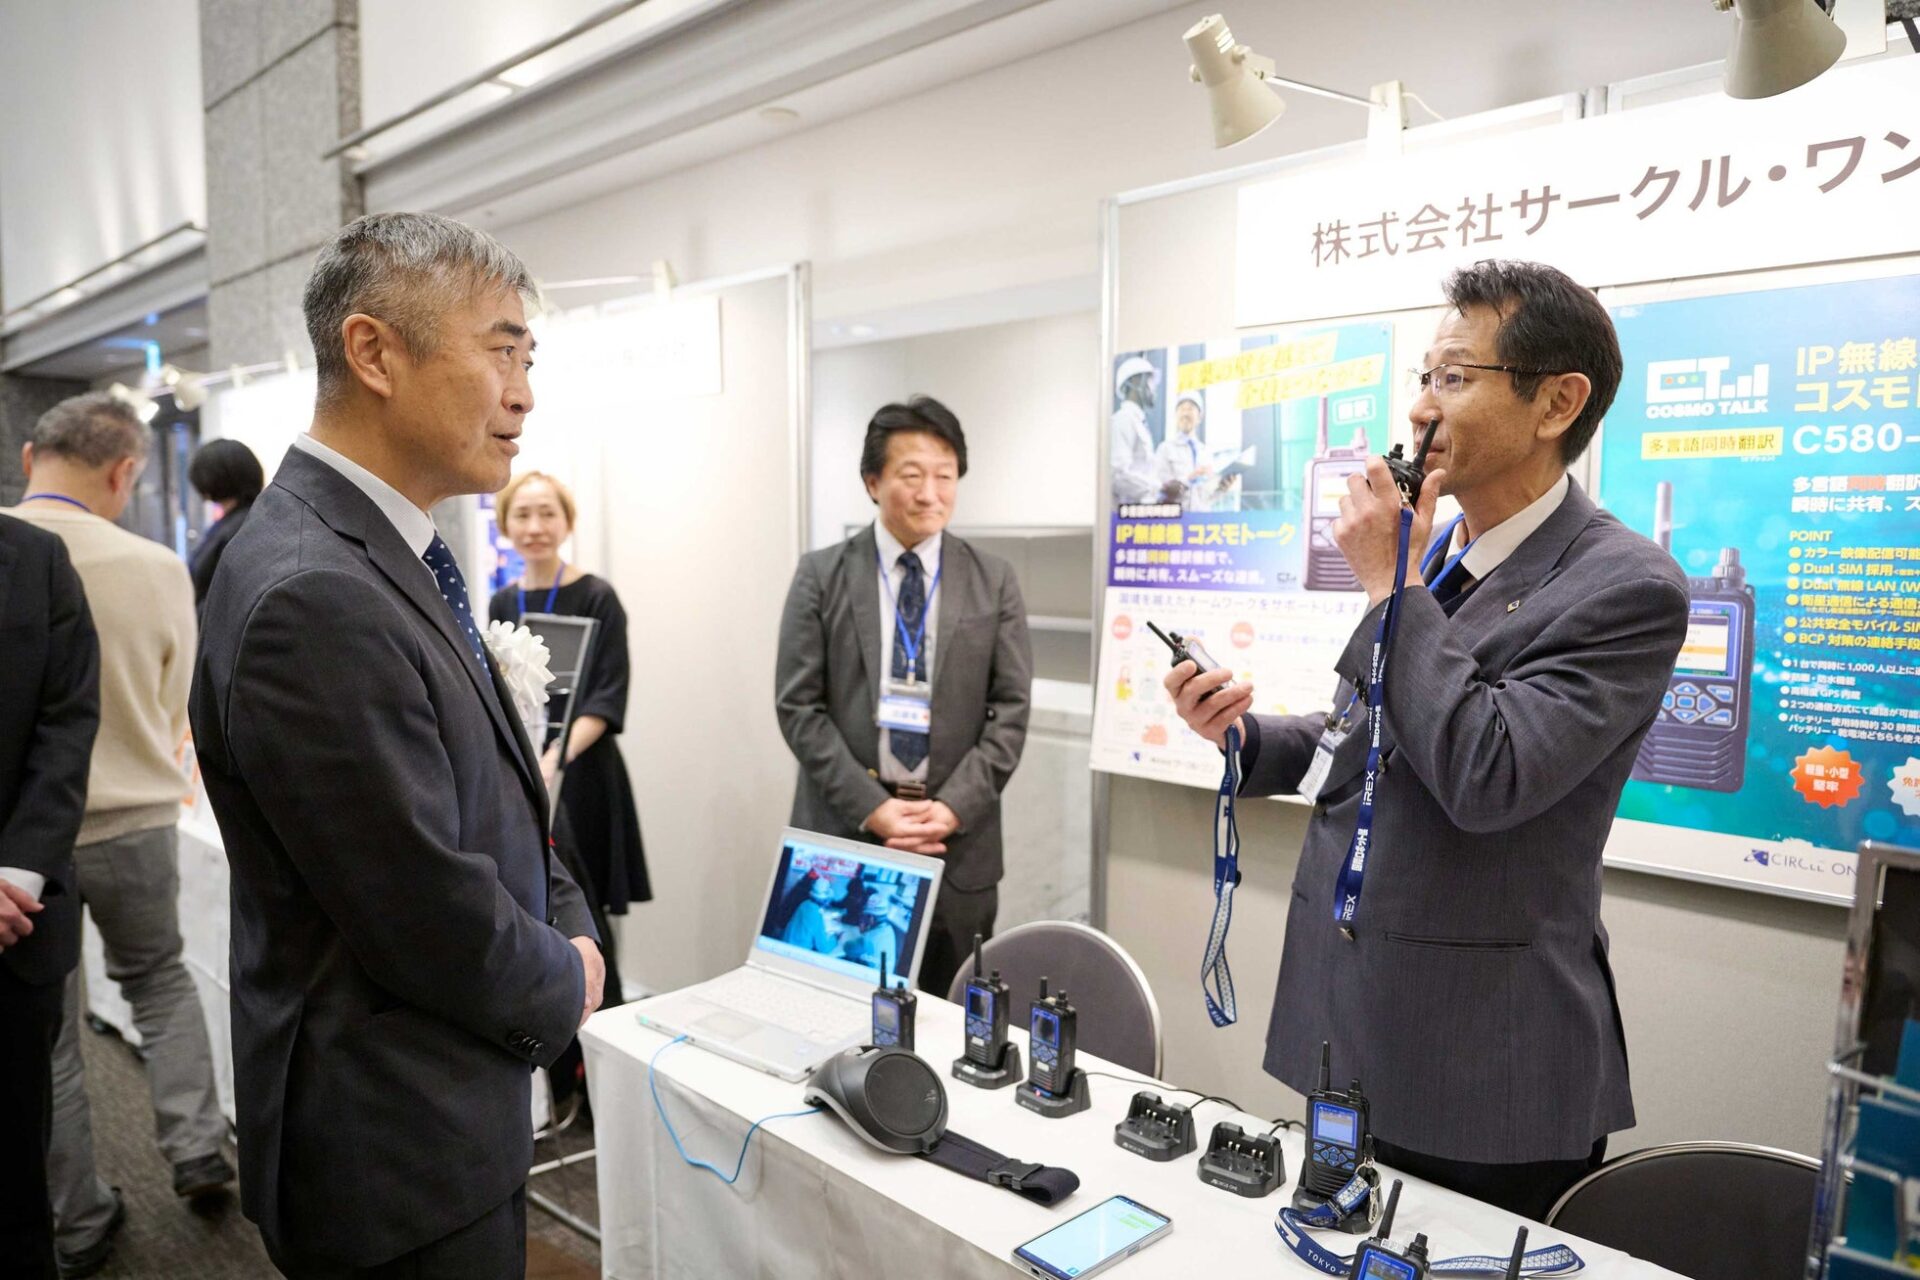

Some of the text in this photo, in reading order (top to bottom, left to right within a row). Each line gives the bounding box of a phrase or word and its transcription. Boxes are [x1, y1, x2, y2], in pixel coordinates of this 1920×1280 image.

[1311, 131, 1920, 267] 株式会社サークル・ワン
[1796, 337, 1918, 376] IP無線
[1794, 375, 1920, 412] コスモ
[1646, 399, 1769, 419] COSMO TALK
[1650, 433, 1775, 453] 多言語同時翻訳
[1187, 523, 1296, 546] コスモトーク
[1789, 530, 1832, 542] POINT
[1803, 563, 1835, 575] Dual
[1838, 564, 1863, 575] SIM
[1802, 579, 1834, 591] Dual
[1866, 581, 1897, 592] LAN
[1800, 594, 1920, 610] 衛星通信による通信
[1799, 633, 1826, 645] BCP
[1362, 770, 1375, 806] iREX
[1307, 1248, 1337, 1274] TOKYO
